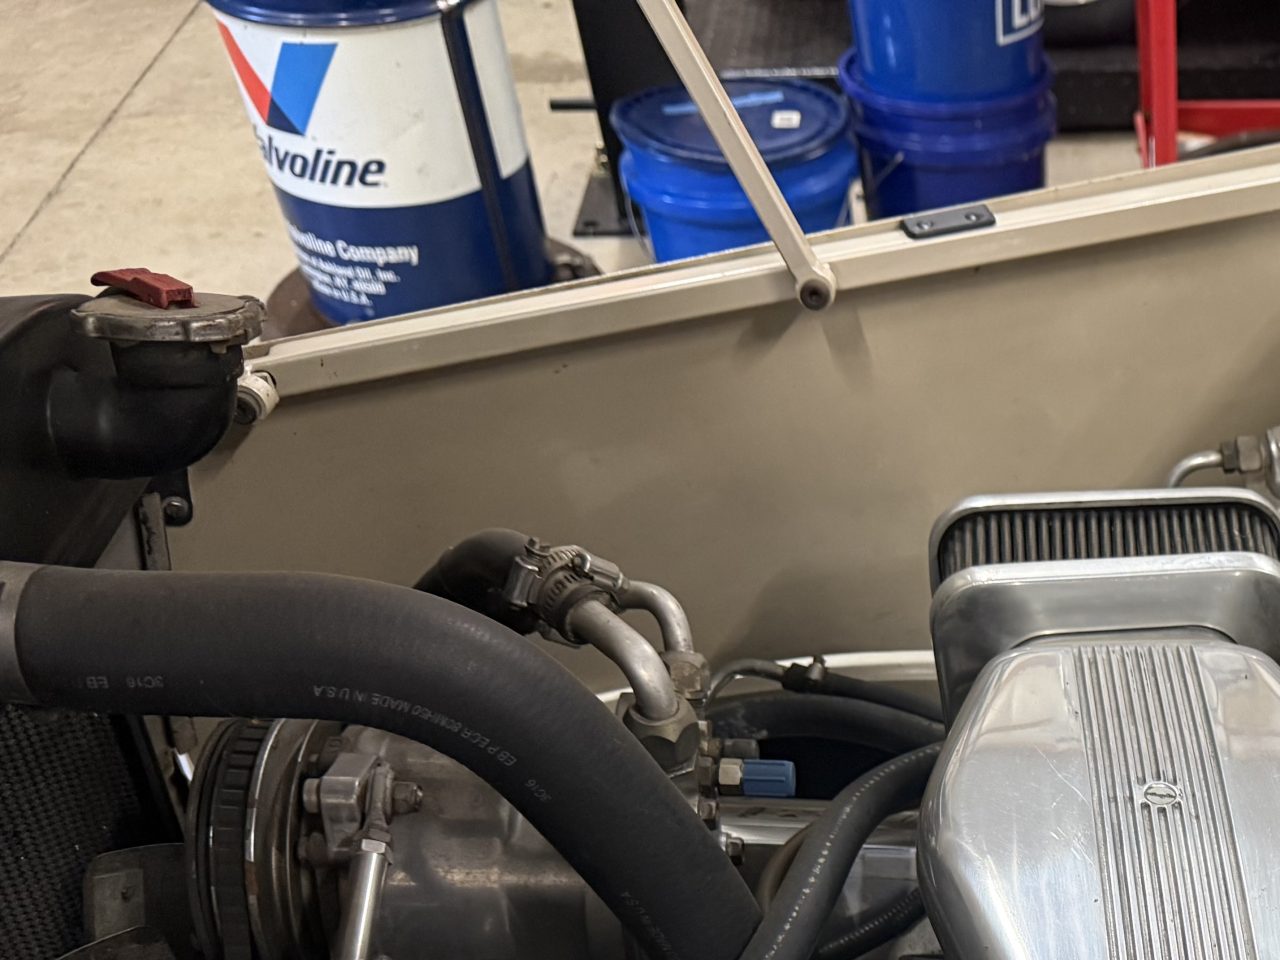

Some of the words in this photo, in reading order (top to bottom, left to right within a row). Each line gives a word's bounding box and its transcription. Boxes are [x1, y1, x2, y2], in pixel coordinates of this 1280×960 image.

[258, 130, 387, 187] lvoline
[335, 239, 419, 267] Company
[370, 692, 411, 712] MADE
[496, 749, 517, 766] EB
